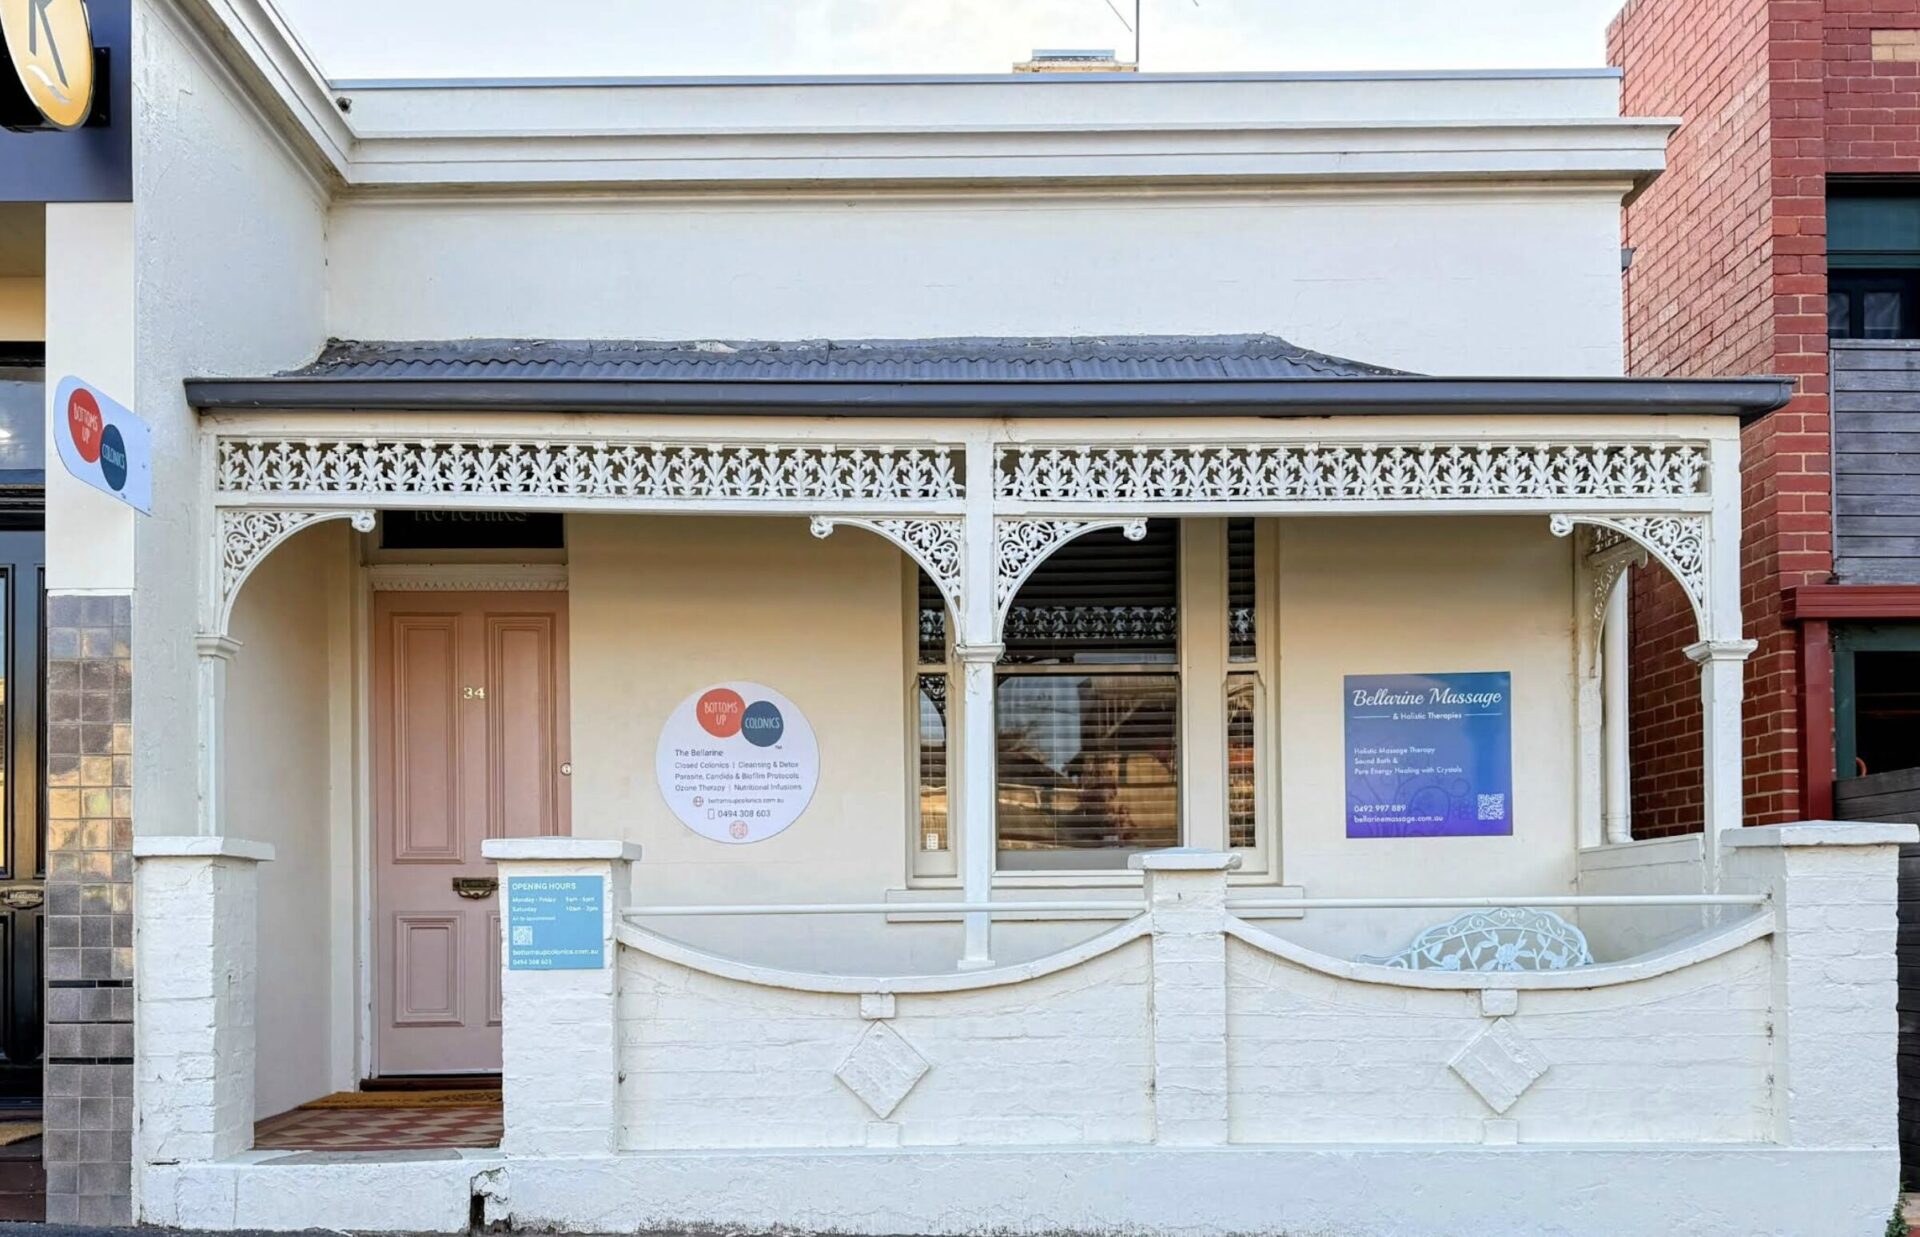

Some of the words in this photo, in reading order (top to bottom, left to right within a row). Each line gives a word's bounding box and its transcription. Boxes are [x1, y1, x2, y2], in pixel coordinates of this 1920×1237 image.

[74, 402, 98, 432] BOTTOMS
[82, 427, 90, 444] UP
[102, 444, 125, 469] COLONICS
[464, 687, 485, 699] 34
[1353, 688, 1424, 706] Bellarine
[1430, 688, 1502, 708] Massage
[704, 702, 738, 714] BOTTOMS
[716, 715, 726, 725] UP
[1428, 712, 1462, 720] Therapies
[745, 717, 780, 729] COLONICS
[738, 761, 771, 769] Cleansing
